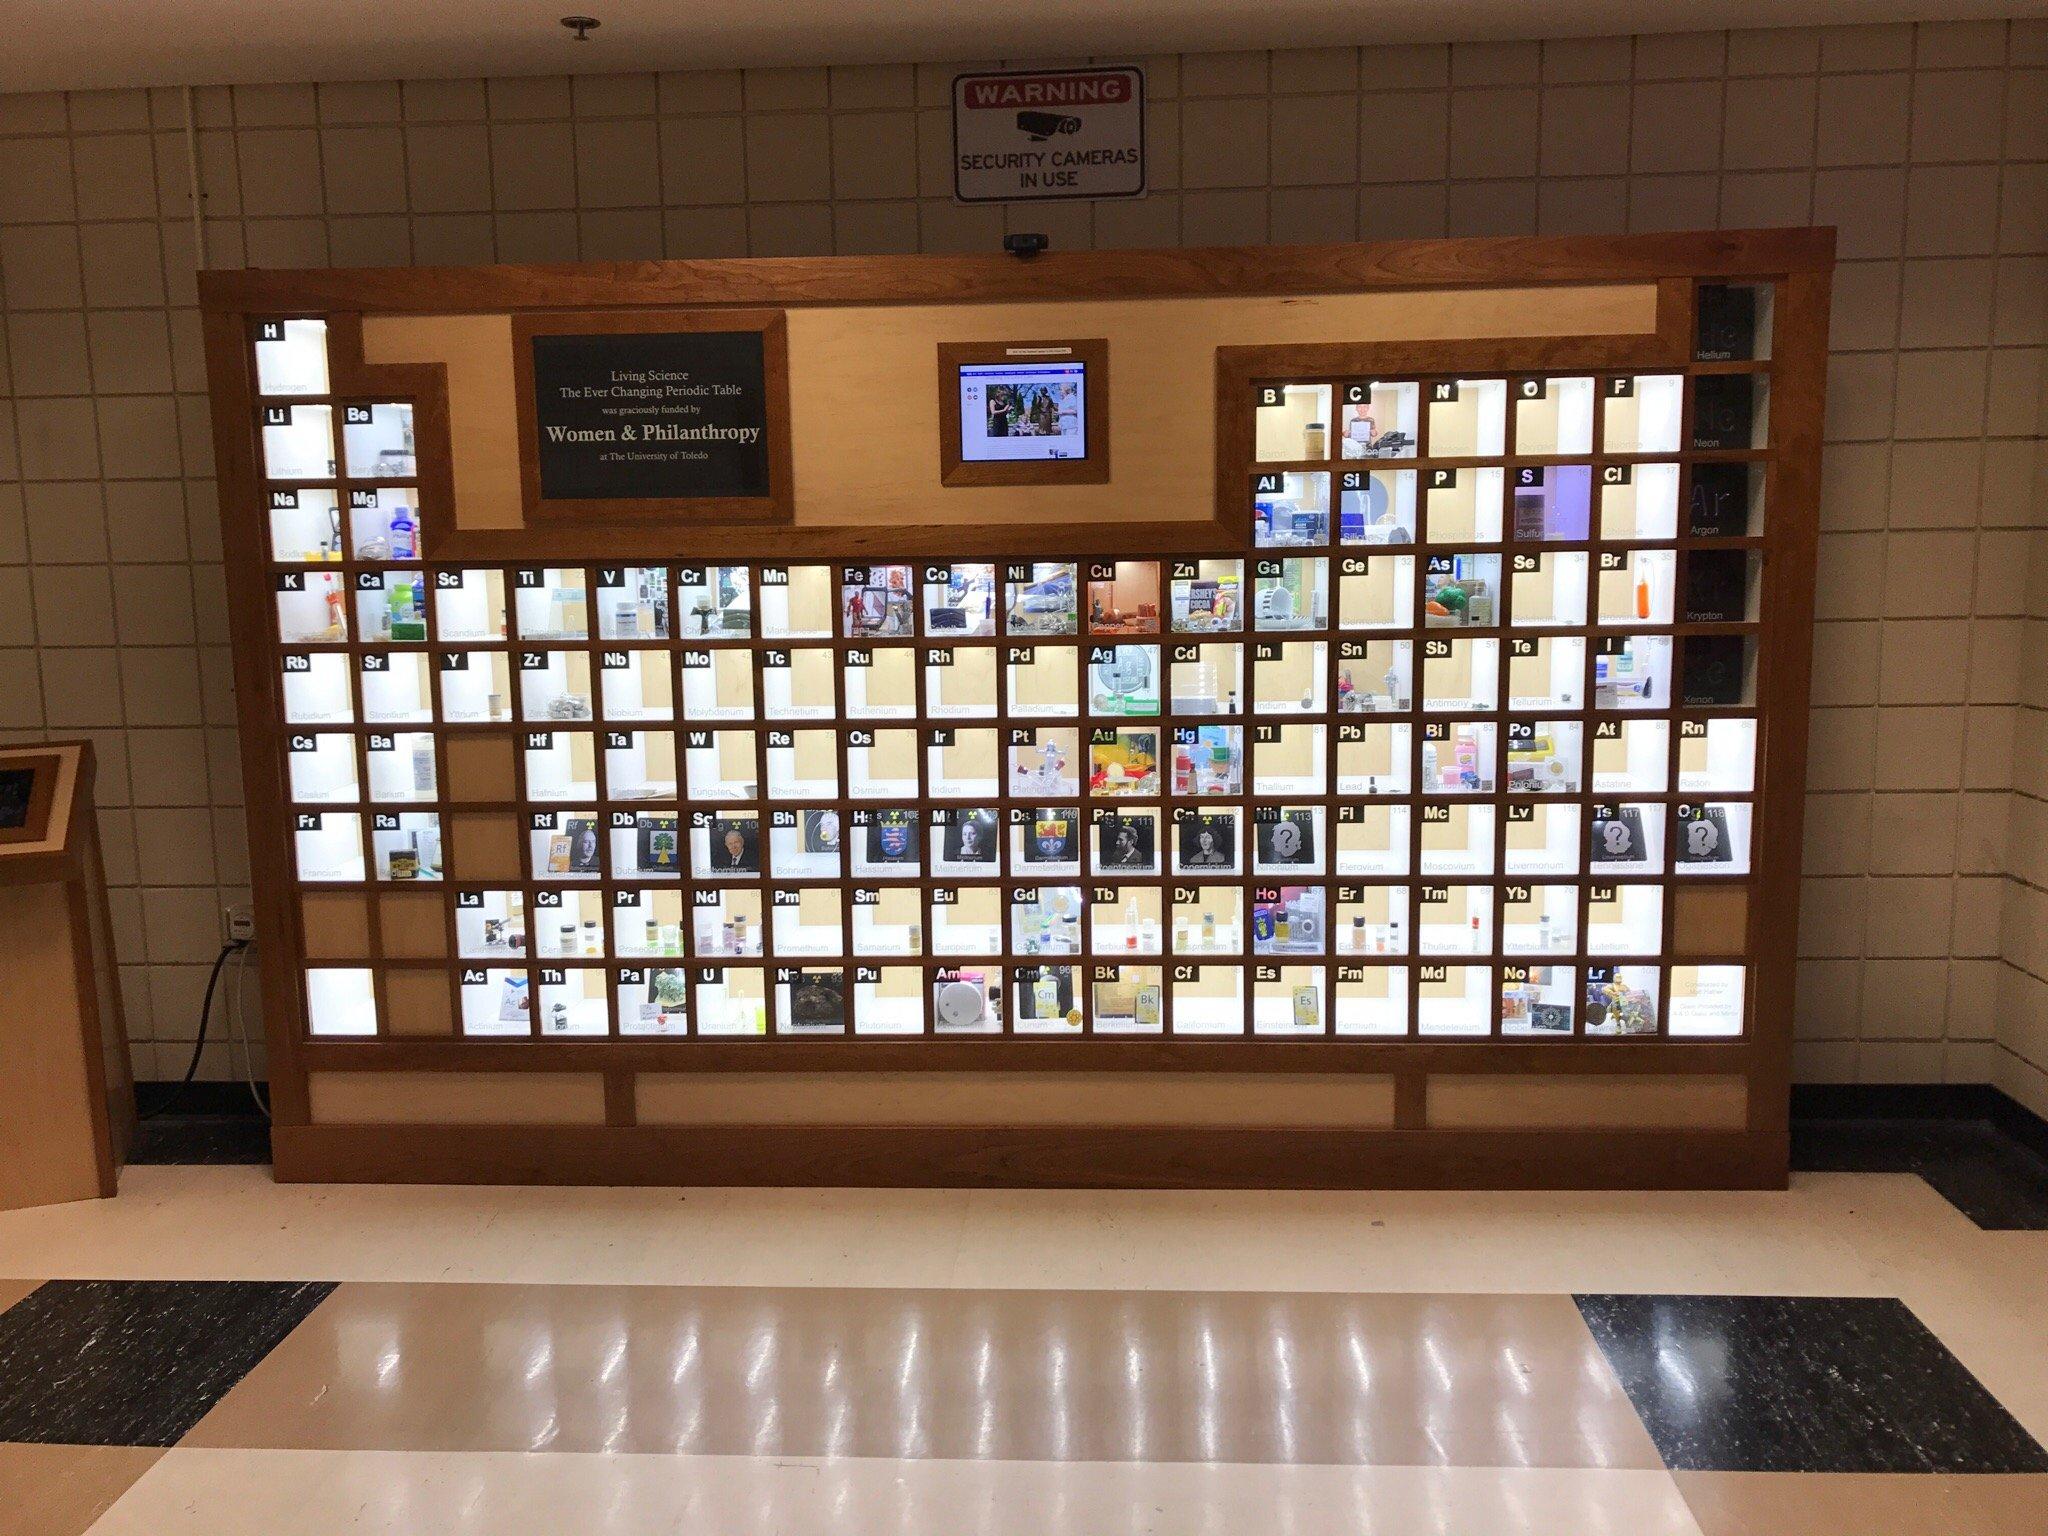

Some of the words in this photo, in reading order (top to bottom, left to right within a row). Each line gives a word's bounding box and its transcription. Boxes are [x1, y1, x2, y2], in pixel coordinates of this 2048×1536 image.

[976, 79, 1122, 104] WARNING
[961, 152, 1045, 170] SECURITY
[1052, 148, 1138, 166] CAMERAS
[1020, 172, 1038, 188] IN
[1043, 170, 1078, 187] USE
[264, 323, 277, 338] H
[1697, 349, 1731, 359] Helium
[611, 370, 645, 383] Living
[648, 369, 689, 380] Science
[560, 388, 581, 398] The
[584, 387, 608, 397] Ever
[611, 386, 663, 399] Changing
[666, 385, 709, 396] Periodic
[712, 384, 741, 395] Table
[1349, 386, 1362, 401] C
[1437, 384, 1450, 398] N
[1523, 381, 1538, 396] O
[1614, 379, 1626, 394] F
[1264, 389, 1276, 403] B
[269, 408, 284, 423] Li
[347, 406, 368, 421] Be
[619, 405, 659, 416] graciously
[661, 405, 688, 414] funded
[690, 404, 701, 415] by
[546, 425, 616, 442] Women
[621, 424, 637, 441] &
[642, 423, 759, 444] Philanthropy
[1693, 438, 1719, 448] Neon
[600, 453, 608, 461] at
[610, 452, 625, 461] The
[627, 451, 668, 462] University
[669, 451, 679, 460] of
[681, 450, 708, 460] Toledo
[1344, 473, 1359, 487] Si
[1435, 471, 1447, 485] P
[1521, 468, 1533, 483] S
[1604, 466, 1622, 481] Cl
[1258, 476, 1275, 490] Al
[273, 492, 295, 506] Na
[353, 491, 376, 508] Mg
[1691, 524, 1719, 536] Argon
[1342, 559, 1364, 573] Ge
[1429, 556, 1450, 570] As
[1514, 554, 1535, 570] Se
[1601, 553, 1620, 568] Br
[845, 568, 863, 582] Fe
[926, 567, 949, 581] Co
[1008, 566, 1024, 580] Ni
[1091, 564, 1113, 578] Cu
[1174, 563, 1195, 577] Zn
[1257, 561, 1280, 575] Ga
[285, 574, 297, 588] K
[359, 573, 381, 587] Ca
[439, 572, 458, 586] Sc
[519, 571, 534, 584] Ti
[604, 570, 616, 584] V
[681, 569, 700, 583] Cr
[763, 569, 787, 583] Mn
[1686, 610, 1723, 621] Krypton
[1257, 645, 1272, 658] In
[1341, 642, 1362, 656] Sn
[1426, 641, 1448, 655] Sb
[1512, 639, 1532, 653] Te
[1606, 638, 1612, 651] I
[524, 653, 541, 667] Zr
[605, 652, 626, 666] Nb
[686, 651, 709, 665] Mo
[767, 651, 785, 665] Tc
[848, 651, 870, 664] Ru
[929, 649, 951, 663] Rh
[1009, 648, 1031, 661] Pd
[1091, 647, 1113, 663] Ag
[1174, 646, 1197, 660] Cd
[286, 656, 308, 670] Rb
[365, 655, 382, 669] Sr
[448, 654, 459, 667] Y
[1684, 695, 1713, 704] Xenon
[1257, 726, 1272, 740] Tl
[1339, 725, 1361, 739] Pb
[1426, 724, 1443, 738] Bi
[1509, 723, 1531, 738] Po
[1596, 721, 1616, 736] At
[1682, 720, 1704, 734] Rn
[292, 735, 314, 749] Cs
[370, 735, 391, 749] Ba
[529, 733, 547, 747] Hf
[608, 732, 627, 746] Ta
[690, 732, 706, 745] W
[769, 731, 790, 745] Re
[850, 730, 872, 744] Os
[934, 729, 946, 743] Ir
[1012, 729, 1029, 743] Pt
[1091, 728, 1114, 742] Au
[1174, 727, 1195, 743] Hg
[773, 811, 794, 825] Bh
[1294, 812, 1312, 821] 113
[1339, 806, 1354, 820] Fl
[1424, 806, 1448, 819] Mc
[1509, 805, 1529, 819] Lv
[1593, 804, 1612, 818] Ts
[1622, 808, 1639, 818] 117
[1708, 808, 1725, 818] 118
[299, 814, 315, 827] Fr
[376, 814, 397, 827] Ra
[534, 813, 552, 827] Rf
[613, 812, 634, 825] Db
[1217, 816, 1234, 825] 112
[460, 893, 479, 906] La
[537, 892, 558, 904] Ce
[617, 891, 634, 904] Pr
[696, 891, 717, 904] Nd
[774, 891, 800, 904] Pm
[855, 889, 880, 902] Sm
[934, 889, 954, 901] Eu
[1014, 888, 1036, 901] Gd
[1094, 888, 1114, 900] Tb
[1175, 887, 1196, 904] Dy
[1256, 887, 1277, 900] Ho
[1339, 887, 1356, 900] Er
[1422, 887, 1447, 900] Tm
[1506, 886, 1527, 899] Yb
[1591, 886, 1611, 899] Lu
[464, 969, 484, 982] Ac
[542, 969, 562, 982] Th
[620, 969, 640, 981] Pa
[703, 968, 714, 981] U
[857, 967, 877, 981] Pu
[936, 967, 961, 979] Am
[1095, 966, 1115, 979] Bk
[1175, 966, 1192, 979] Cf
[1256, 966, 1276, 978] Es
[1338, 966, 1363, 979] Fm
[1420, 966, 1444, 979] Md
[1504, 966, 1526, 980] No
[1589, 966, 1605, 980] Lr
[1141, 994, 1153, 1004] Bk
[1300, 996, 1311, 1005] Es
